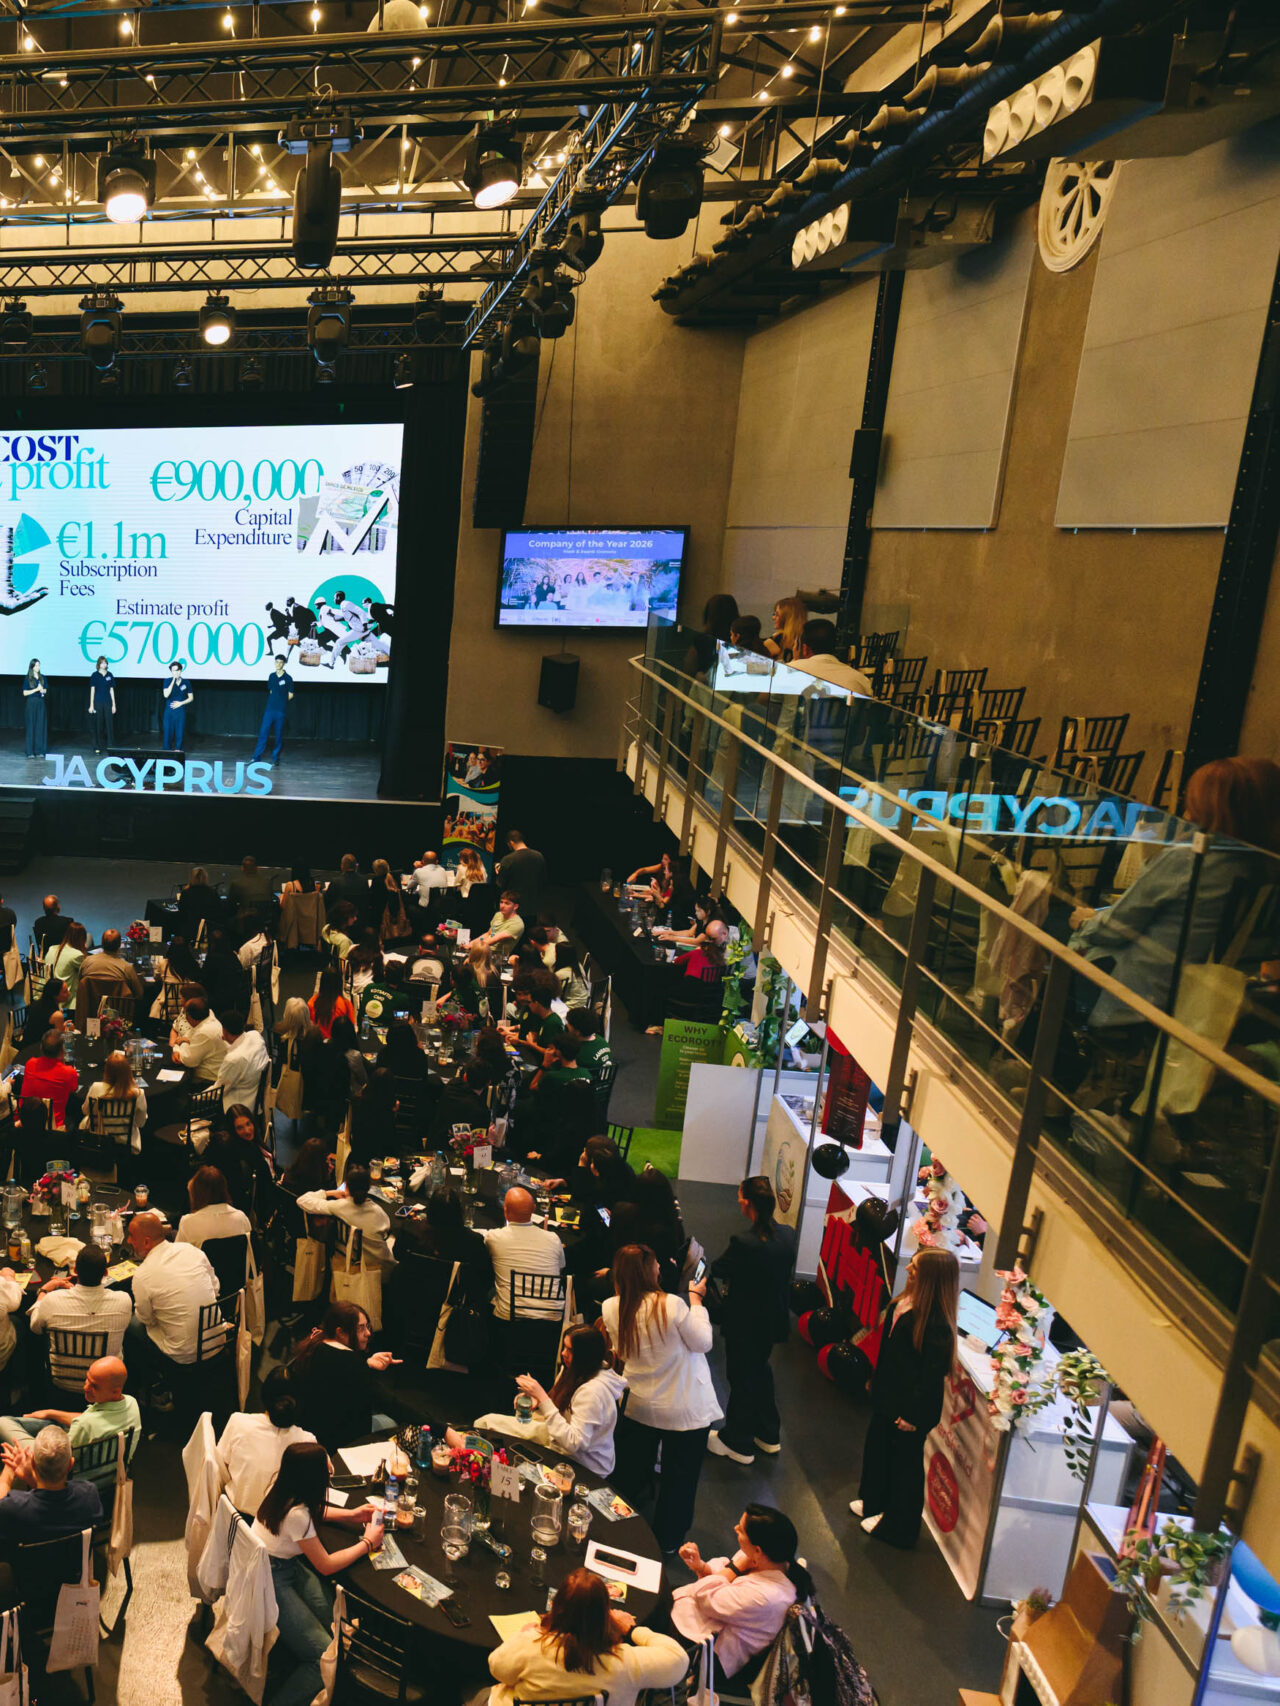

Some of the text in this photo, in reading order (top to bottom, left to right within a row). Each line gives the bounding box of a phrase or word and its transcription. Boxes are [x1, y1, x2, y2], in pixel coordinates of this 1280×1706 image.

[8, 447, 111, 501] profit
[149, 458, 324, 509] €900,000
[235, 508, 292, 531] Capital
[56, 520, 169, 559] €1.1m
[195, 528, 292, 549] Expenditure
[528, 540, 653, 549] Company of the Year 2026
[59, 560, 158, 581] Subscription
[60, 580, 95, 596] Fees
[116, 599, 229, 620] Estimate profit
[78, 620, 265, 672] €570,000
[42, 753, 273, 796] JA CYPRUS
[684, 1026, 707, 1035] WHY
[501, 1476, 512, 1486] 15
